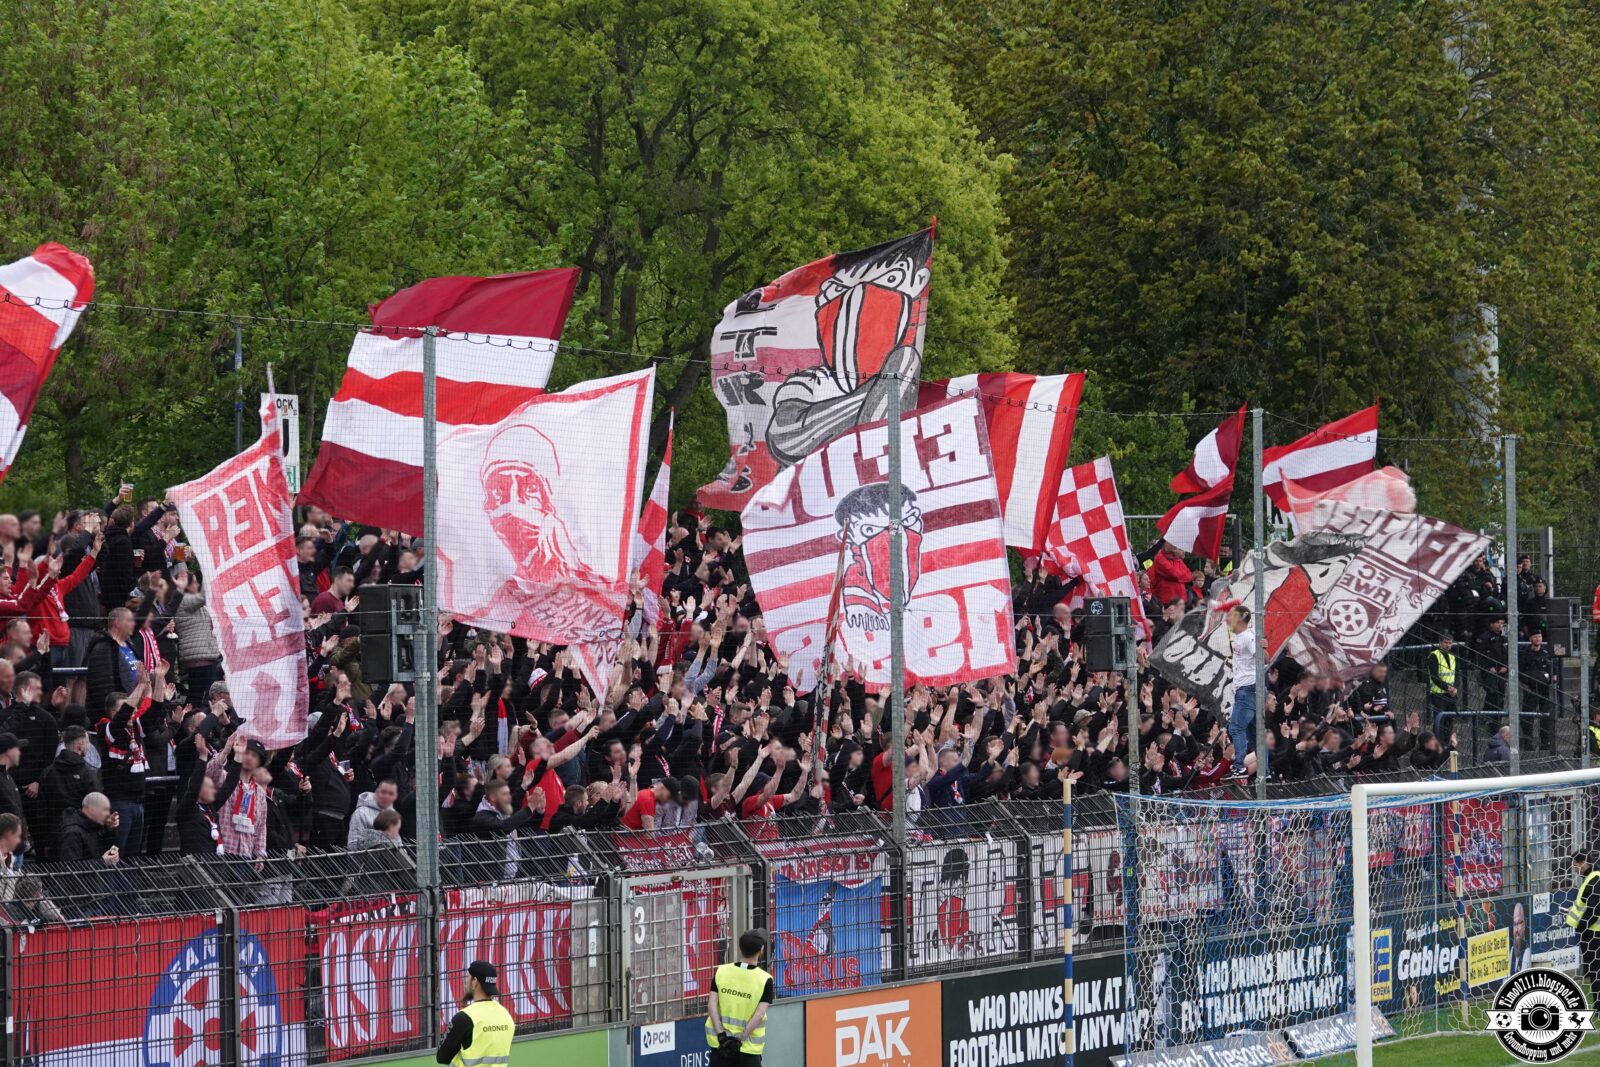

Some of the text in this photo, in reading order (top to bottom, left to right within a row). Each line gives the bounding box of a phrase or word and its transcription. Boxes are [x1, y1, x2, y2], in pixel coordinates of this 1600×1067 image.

[634, 906, 646, 945] 3
[1197, 943, 1333, 995] WHO DRINKS MILK AT A
[1397, 943, 1460, 981] Gabler
[720, 986, 752, 1001] ORDNER
[968, 993, 1006, 1033] WHO
[1009, 985, 1064, 1027] DRINKS
[1104, 976, 1123, 1010] AT
[1126, 975, 1136, 1008] A
[1244, 984, 1287, 1021] MATCH
[1287, 975, 1344, 1014] ANYWAY?
[482, 1024, 509, 1033] ORDNER
[652, 1030, 671, 1046] PCH
[835, 999, 912, 1067] DAK
[949, 1029, 1025, 1067] FOOTBALL
[1079, 1007, 1150, 1052] ANYWAY?
[680, 1051, 702, 1067] DEIN
